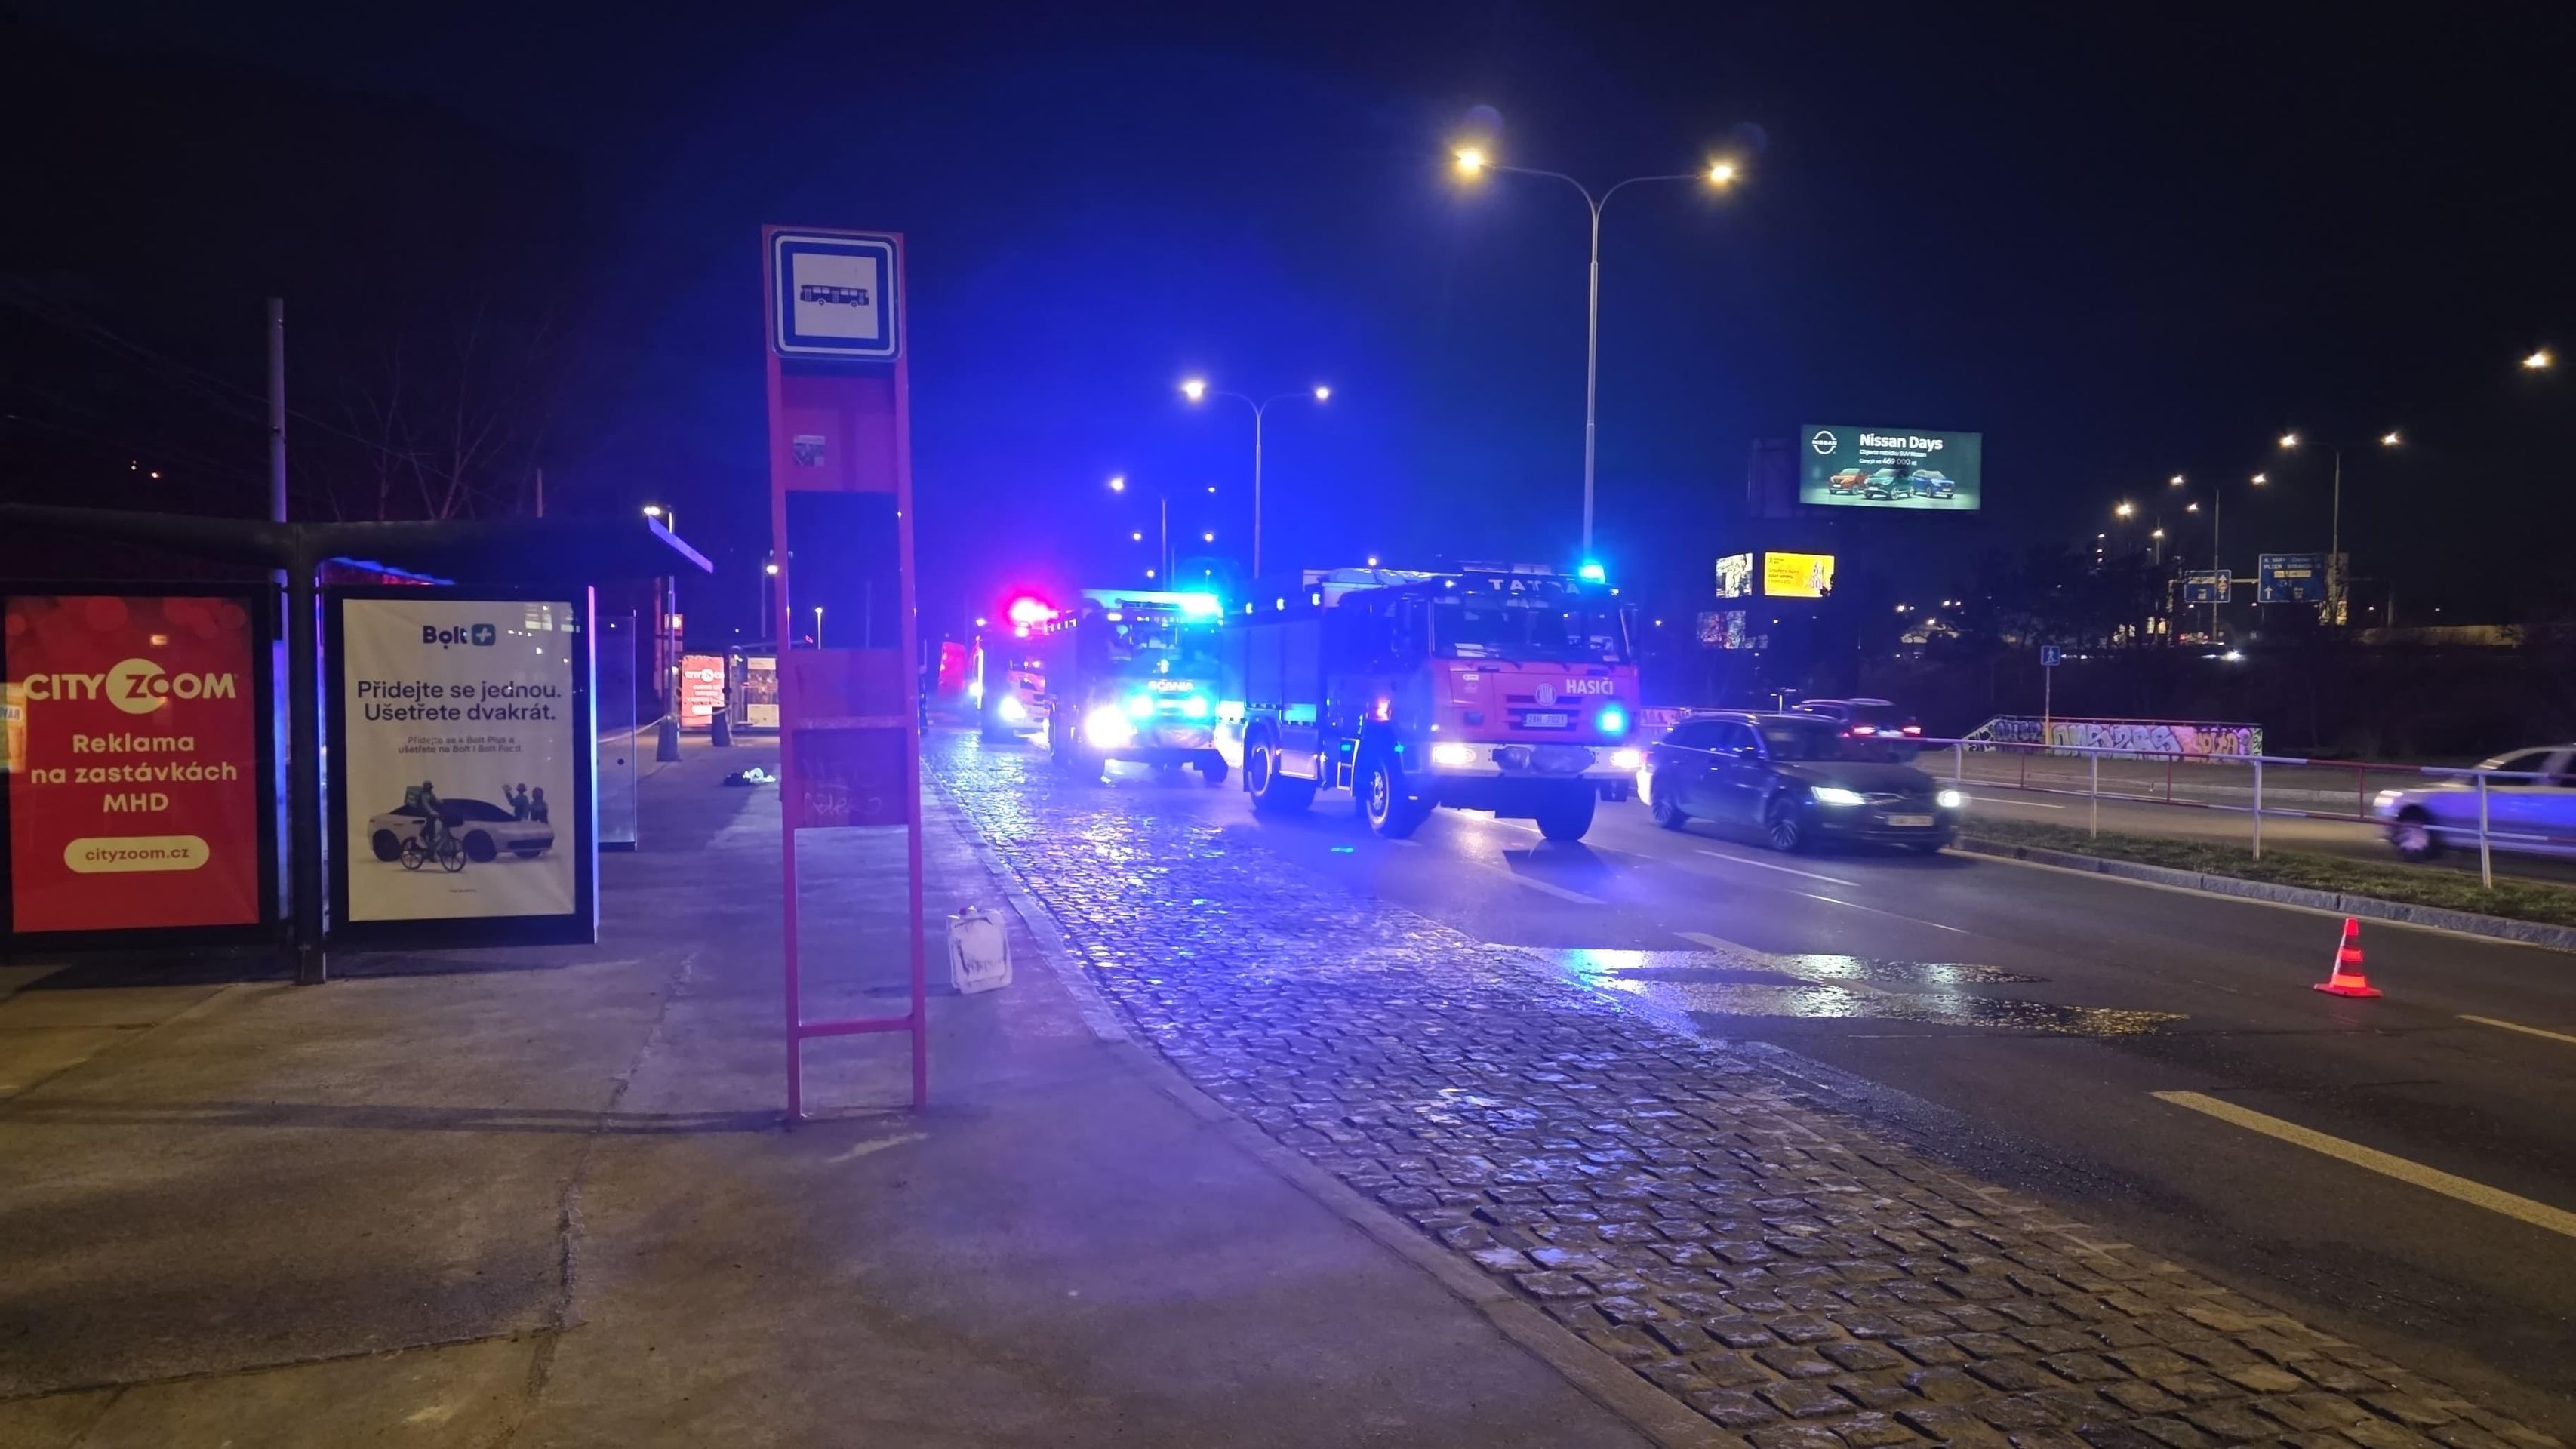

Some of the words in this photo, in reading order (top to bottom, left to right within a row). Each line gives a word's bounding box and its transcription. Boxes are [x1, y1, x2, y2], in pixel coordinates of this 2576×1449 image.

[1860, 433, 1906, 448] Nissan
[1909, 436, 1943, 452] Days
[423, 625, 467, 648] Bolt
[23, 669, 236, 703] CITYZOOM
[358, 681, 444, 702] Přidejte
[450, 685, 475, 698] se
[482, 681, 561, 702] jednou.
[1148, 680, 1193, 691] SCANIA
[1566, 678, 1613, 696] HASIČI
[365, 703, 460, 721] Ušetřete
[466, 703, 556, 721] dvakrát.
[72, 733, 195, 753] Reklama
[31, 766, 66, 784] na
[75, 761, 237, 783] zastávkách
[103, 793, 169, 813] MHD
[85, 846, 189, 863] cityzoom.cz
